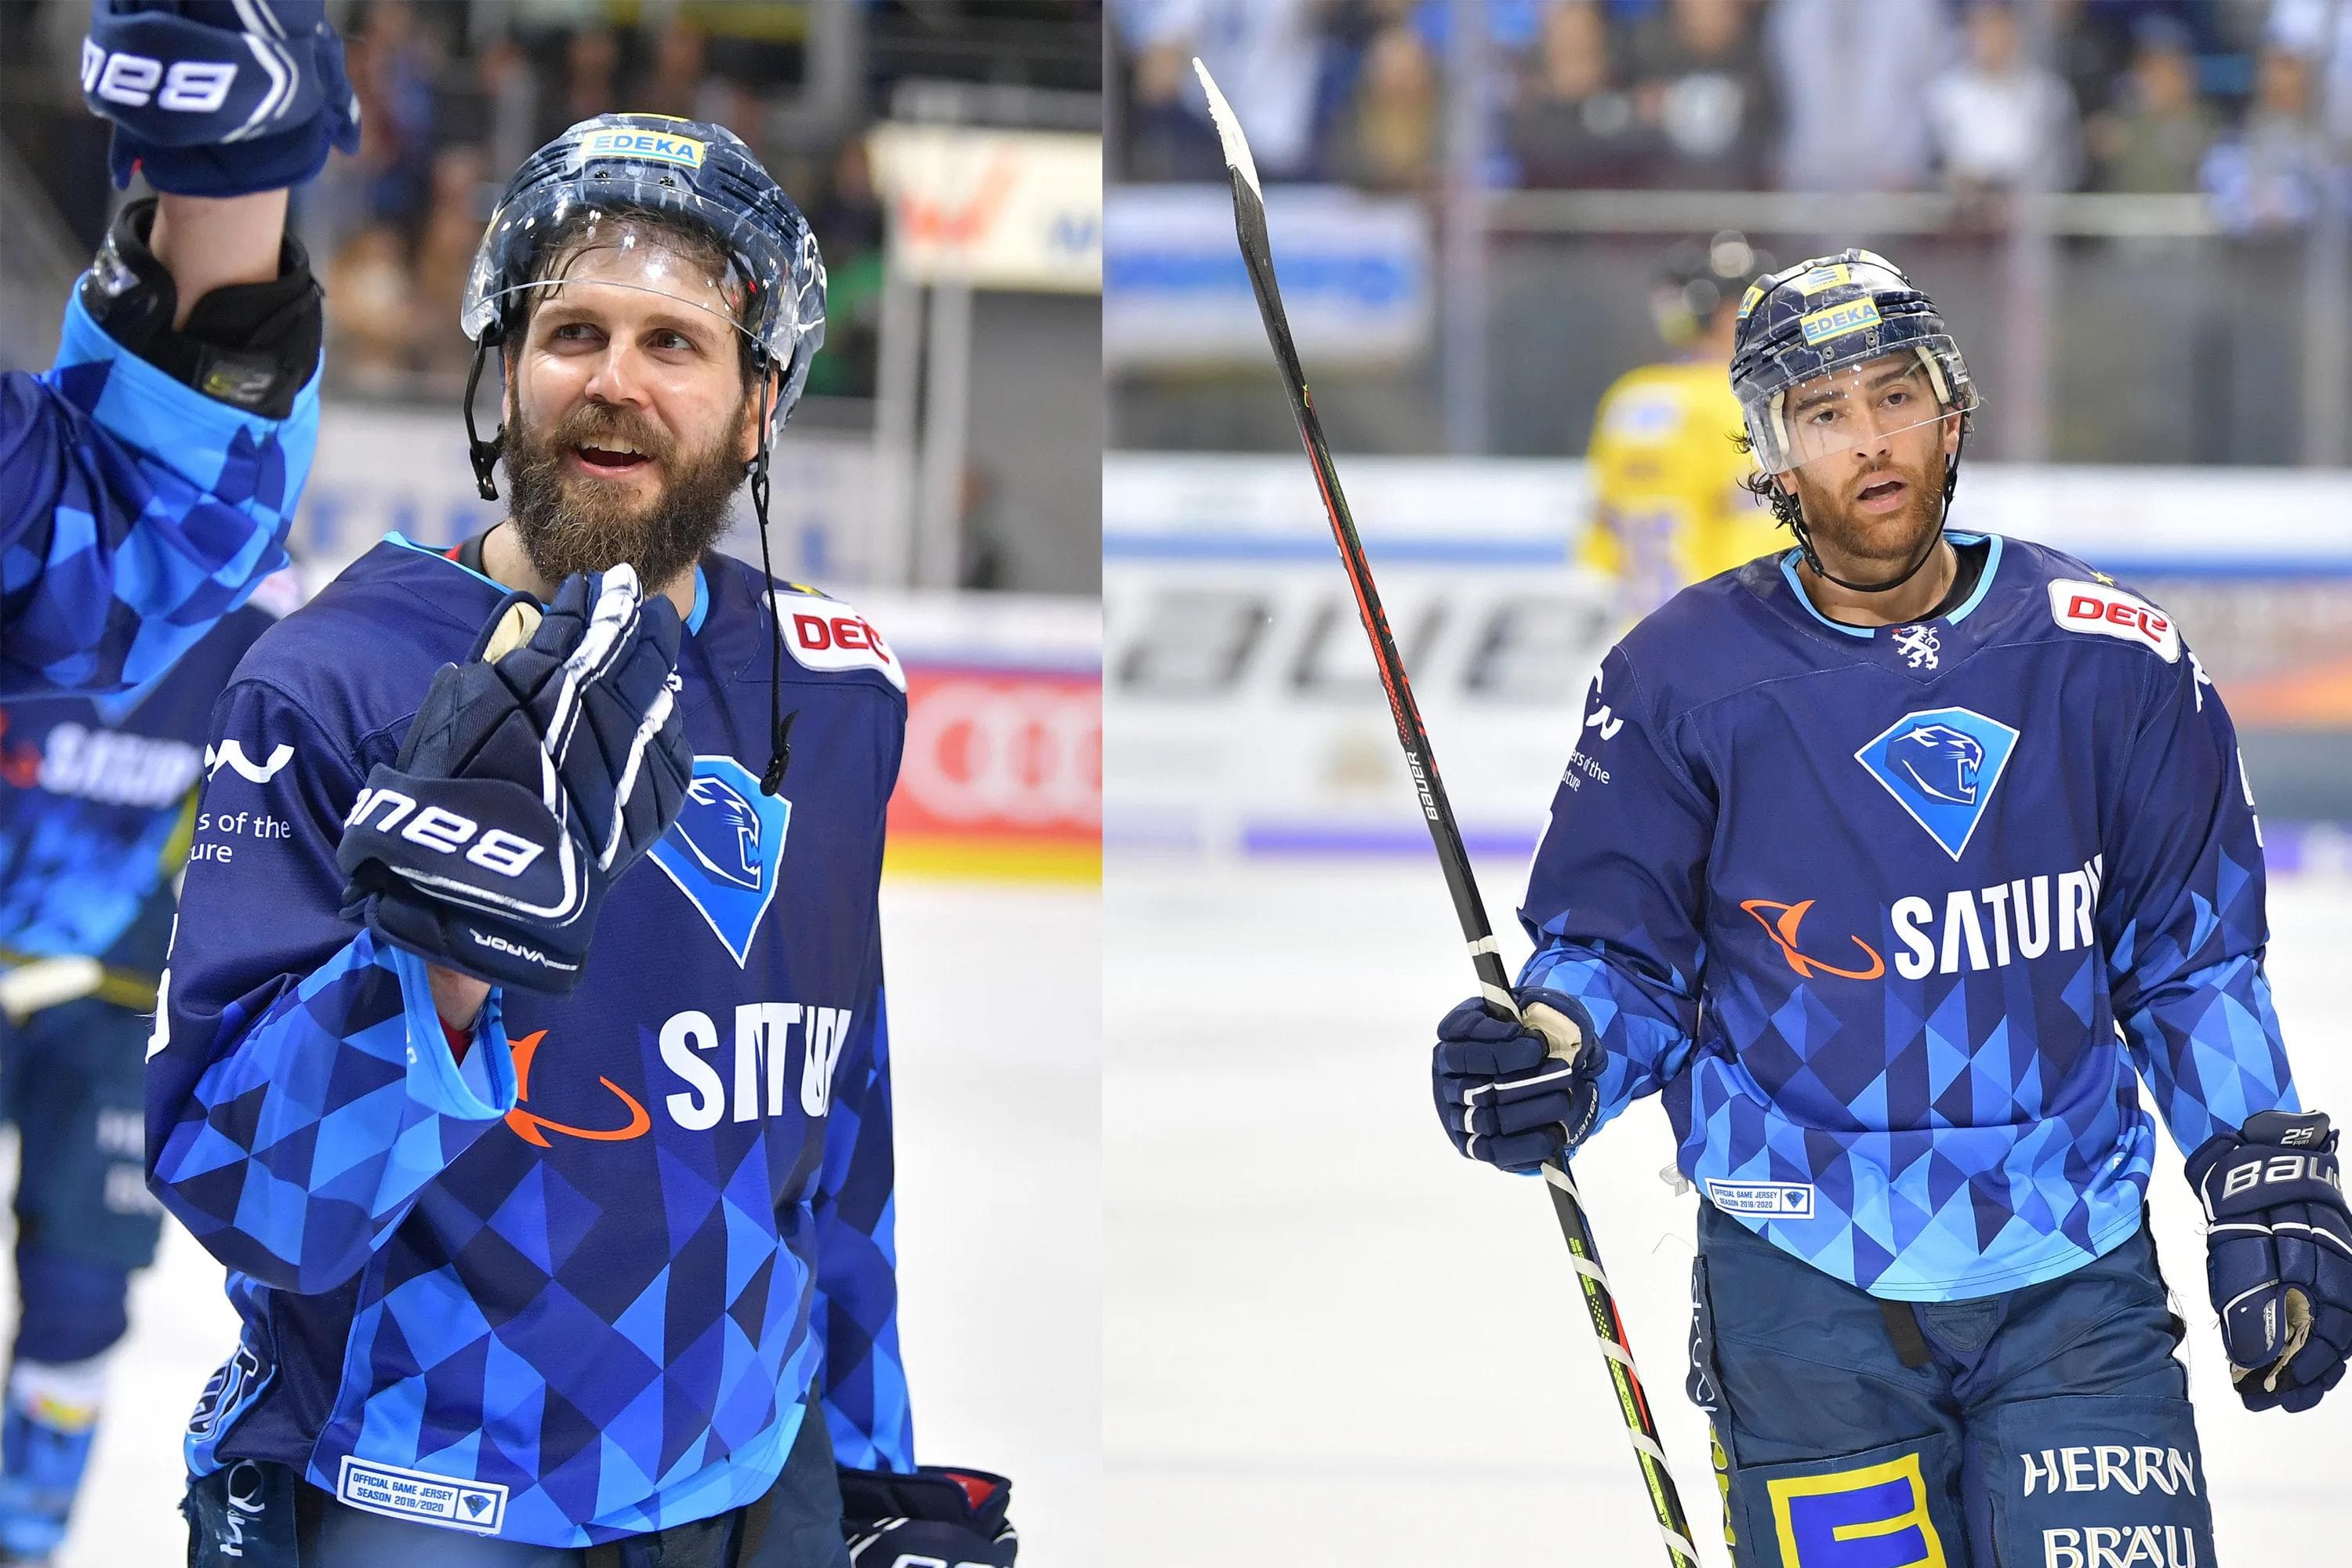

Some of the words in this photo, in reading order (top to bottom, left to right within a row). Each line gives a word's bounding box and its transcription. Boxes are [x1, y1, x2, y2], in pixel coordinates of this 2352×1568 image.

[593, 135, 695, 160] EDEKA
[1804, 304, 1876, 337] EDEKA
[1406, 751, 1439, 821] BAUER
[1588, 762, 1610, 785] the
[218, 811, 249, 834] of
[253, 815, 291, 839] the
[187, 843, 233, 863] ure
[469, 927, 578, 971] VAPOR
[1714, 1189, 1735, 1198] OFFICIAL
[1719, 1198, 1738, 1207] SEASON
[2020, 1445, 2197, 1497] HERRN
[353, 1473, 389, 1490] OFFICIAL
[392, 1482, 417, 1495] GAME
[419, 1487, 453, 1501] JERSEY
[357, 1487, 391, 1503] SEASON
[394, 1496, 444, 1513] 2019/2020
[2042, 1525, 2197, 1568] BRÄU
